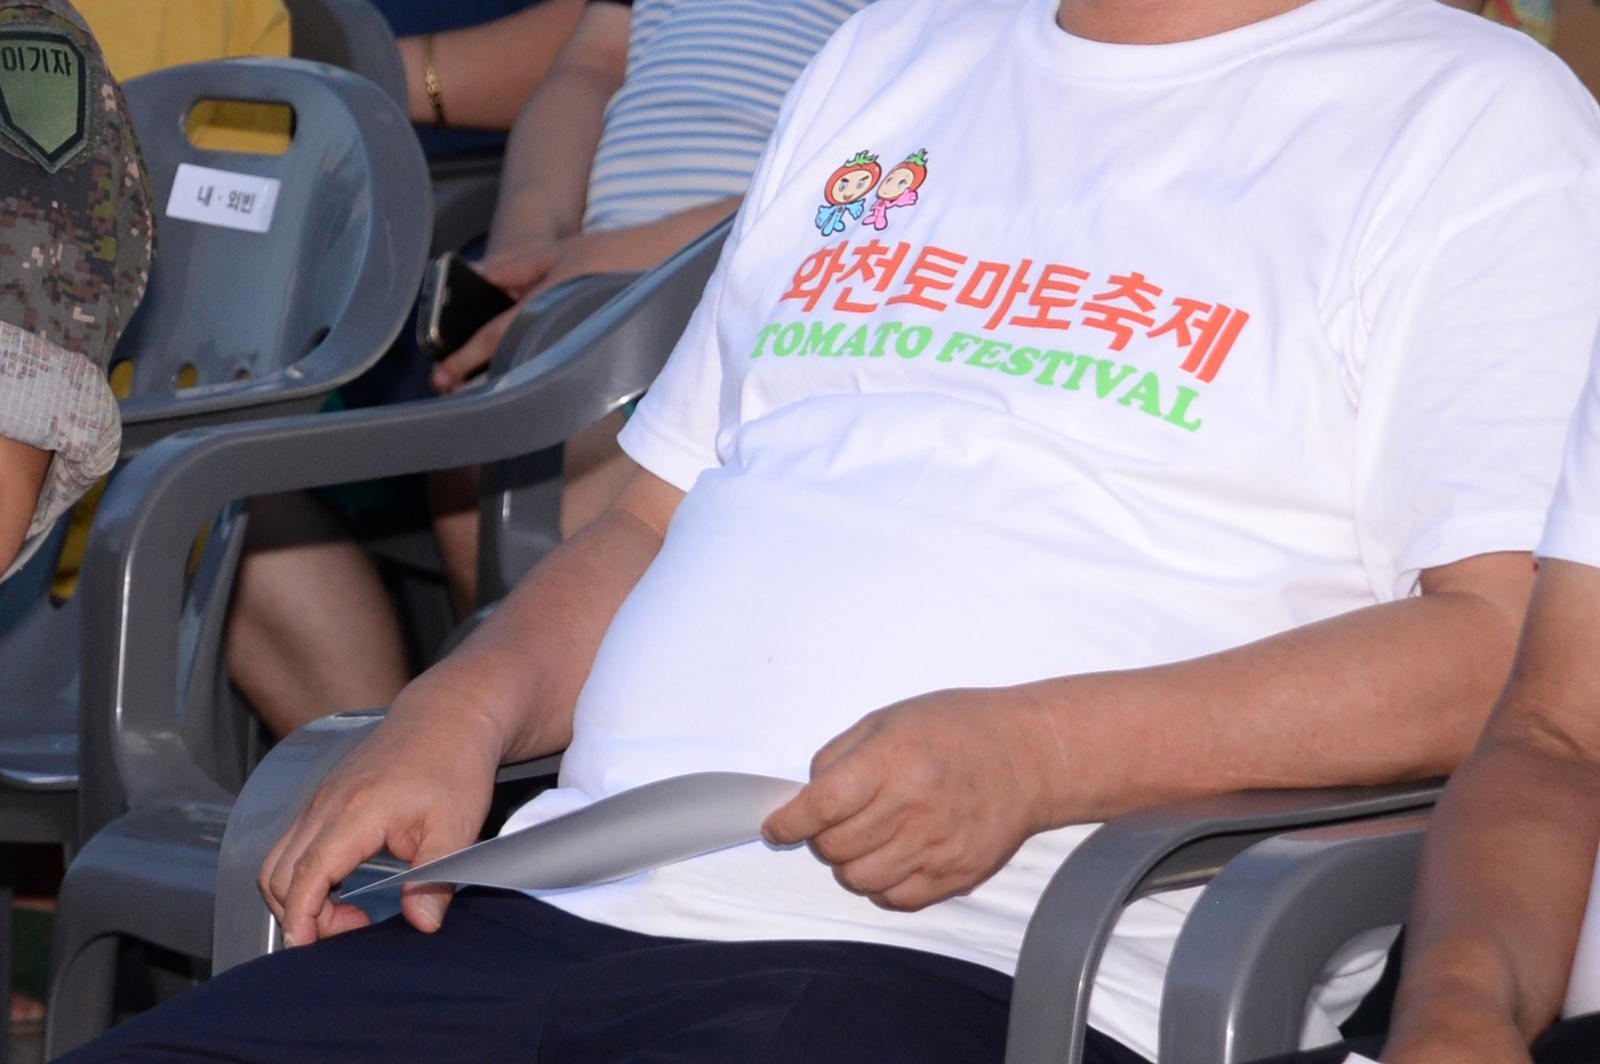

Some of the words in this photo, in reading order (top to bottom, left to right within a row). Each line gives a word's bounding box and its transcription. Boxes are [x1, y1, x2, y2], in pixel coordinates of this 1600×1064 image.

[0, 45, 72, 76] 이기자
[779, 238, 1250, 384] 화천토마토축제
[750, 321, 933, 359] TOMATO
[936, 331, 1202, 433] FESTIVAL
